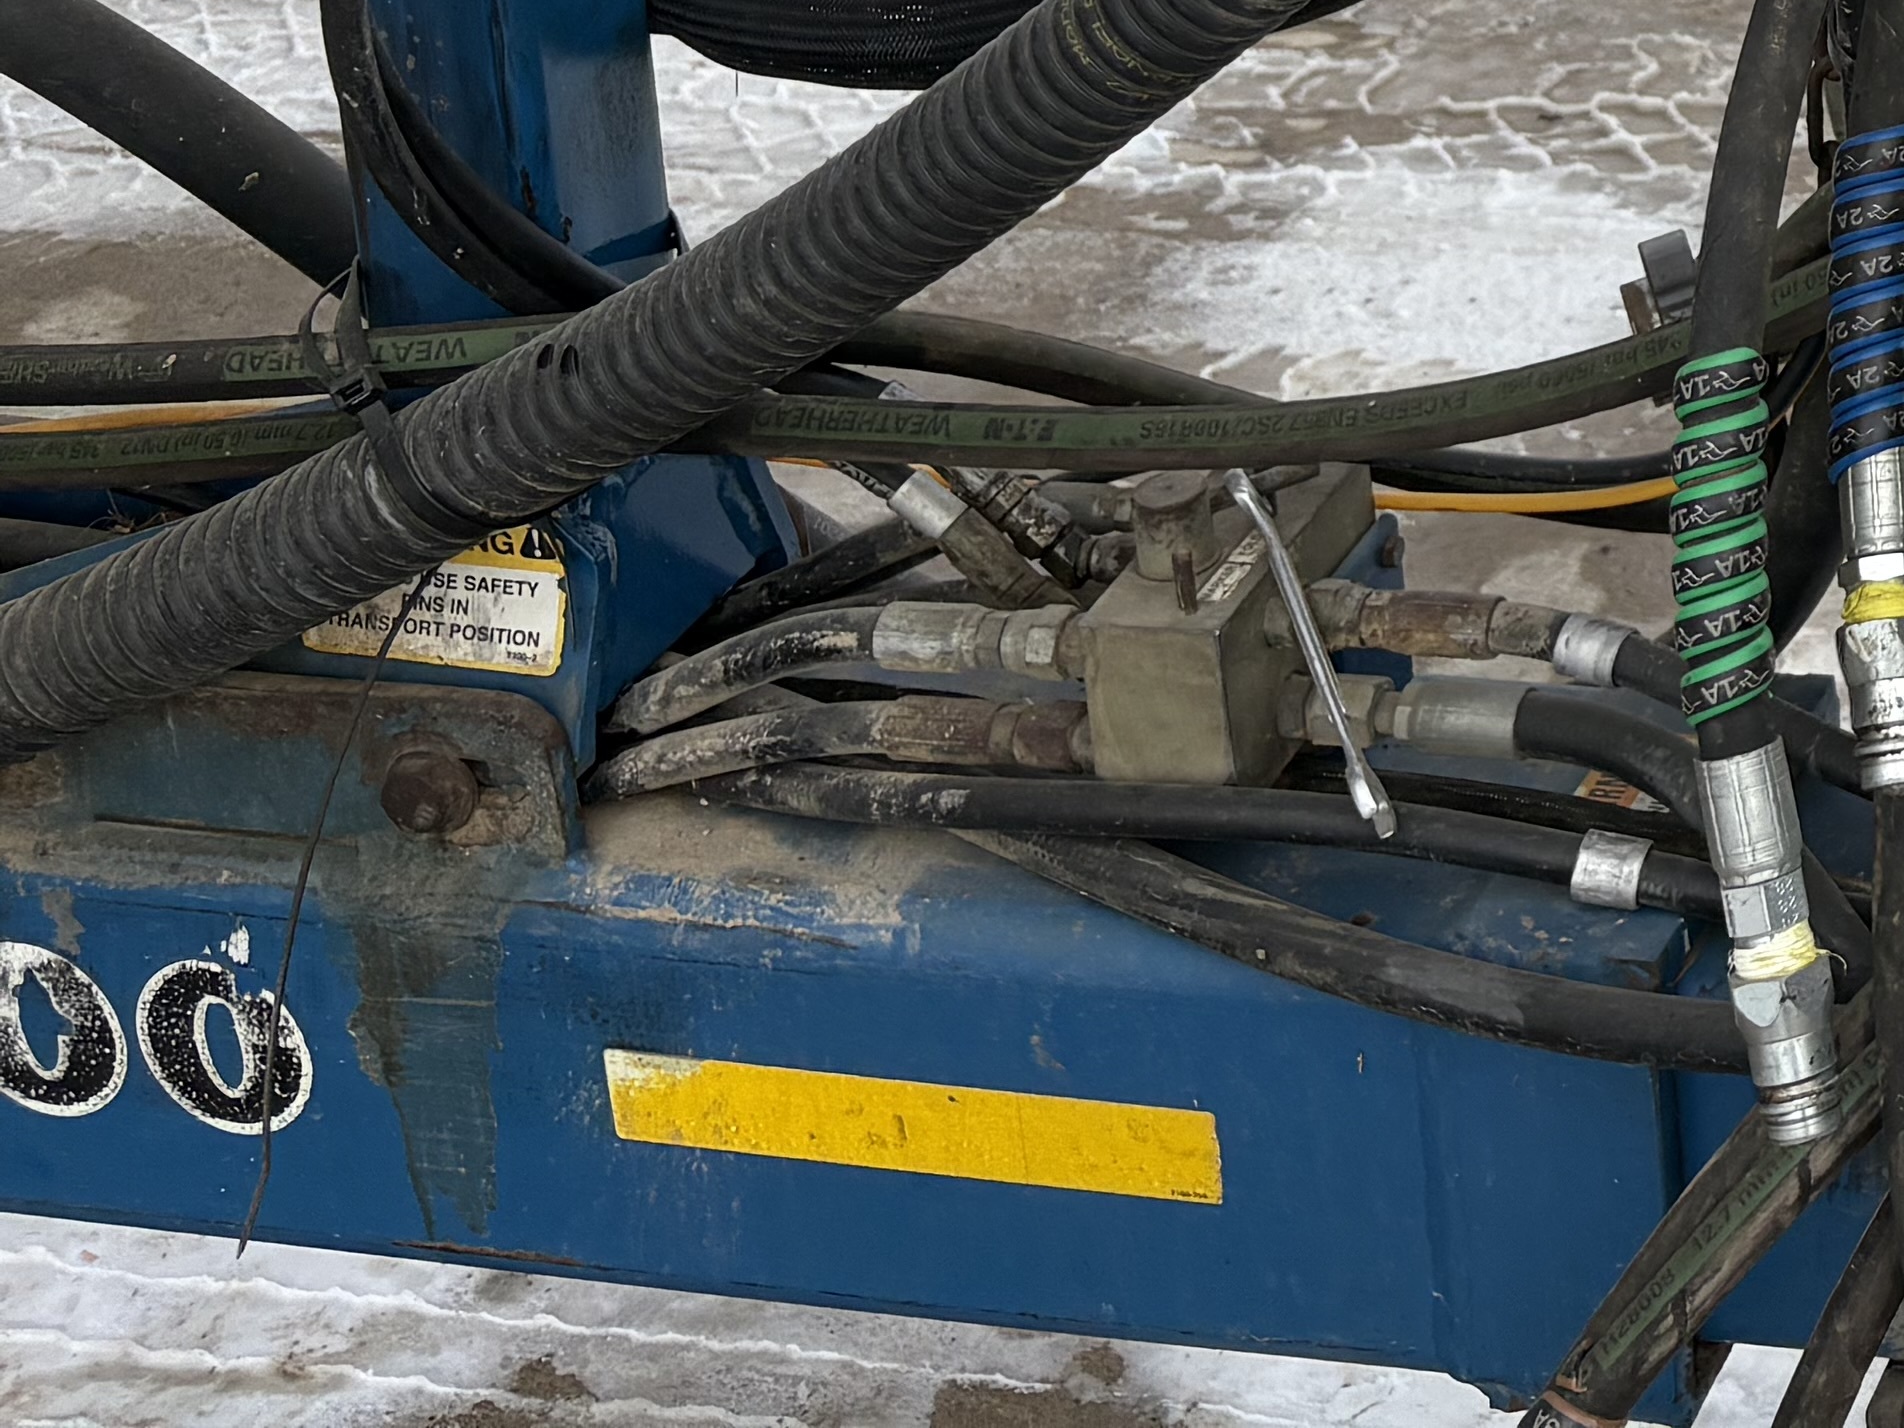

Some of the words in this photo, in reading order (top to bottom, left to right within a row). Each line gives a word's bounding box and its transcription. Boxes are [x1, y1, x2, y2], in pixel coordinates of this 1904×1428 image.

[1835, 206, 1863, 229] 2A
[1859, 255, 1894, 277] 2A
[1679, 373, 1712, 401] 1A
[1845, 366, 1881, 389] 2A
[752, 407, 952, 439] WEATHERHEAD
[1714, 549, 1753, 578] 1A
[463, 574, 540, 598] SAFETY
[450, 598, 470, 616] IN
[449, 623, 542, 649] POSITION
[1703, 611, 1741, 639] 1A
[1700, 677, 1738, 706] 1A
